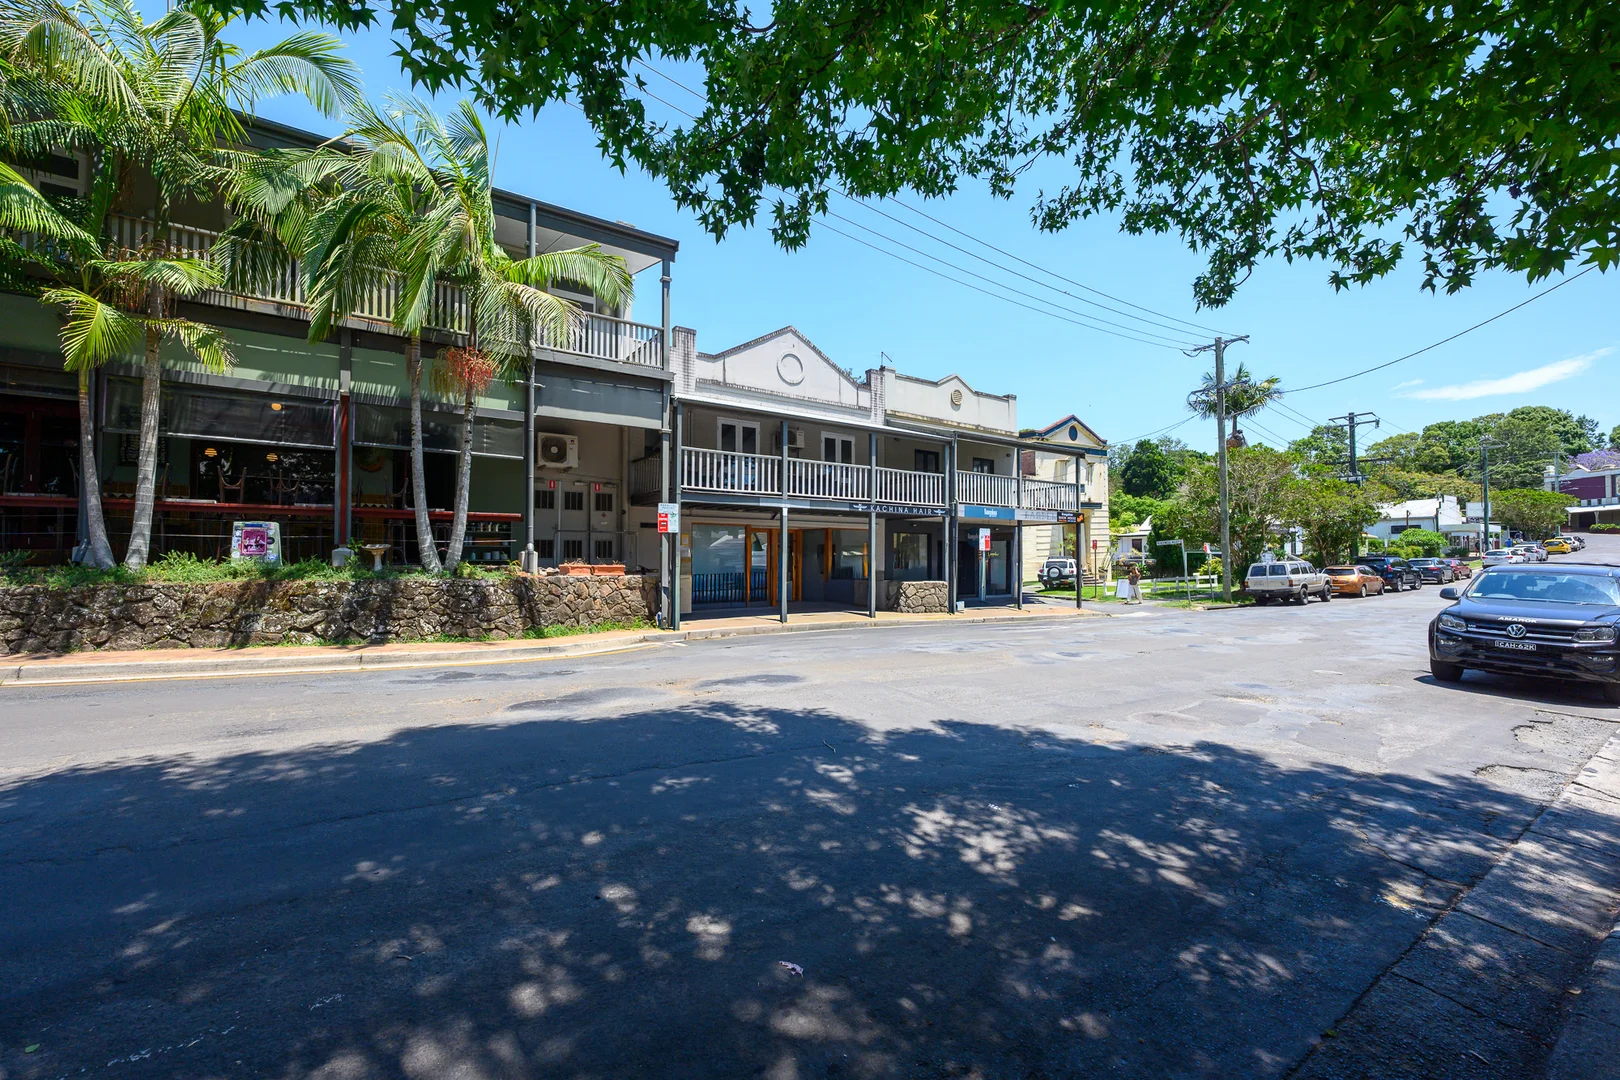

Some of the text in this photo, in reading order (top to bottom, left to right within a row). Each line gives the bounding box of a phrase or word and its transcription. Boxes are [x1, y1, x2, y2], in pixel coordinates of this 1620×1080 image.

[870, 504, 932, 515] KACHINA HAIR
[1497, 616, 1537, 624] AMAROK
